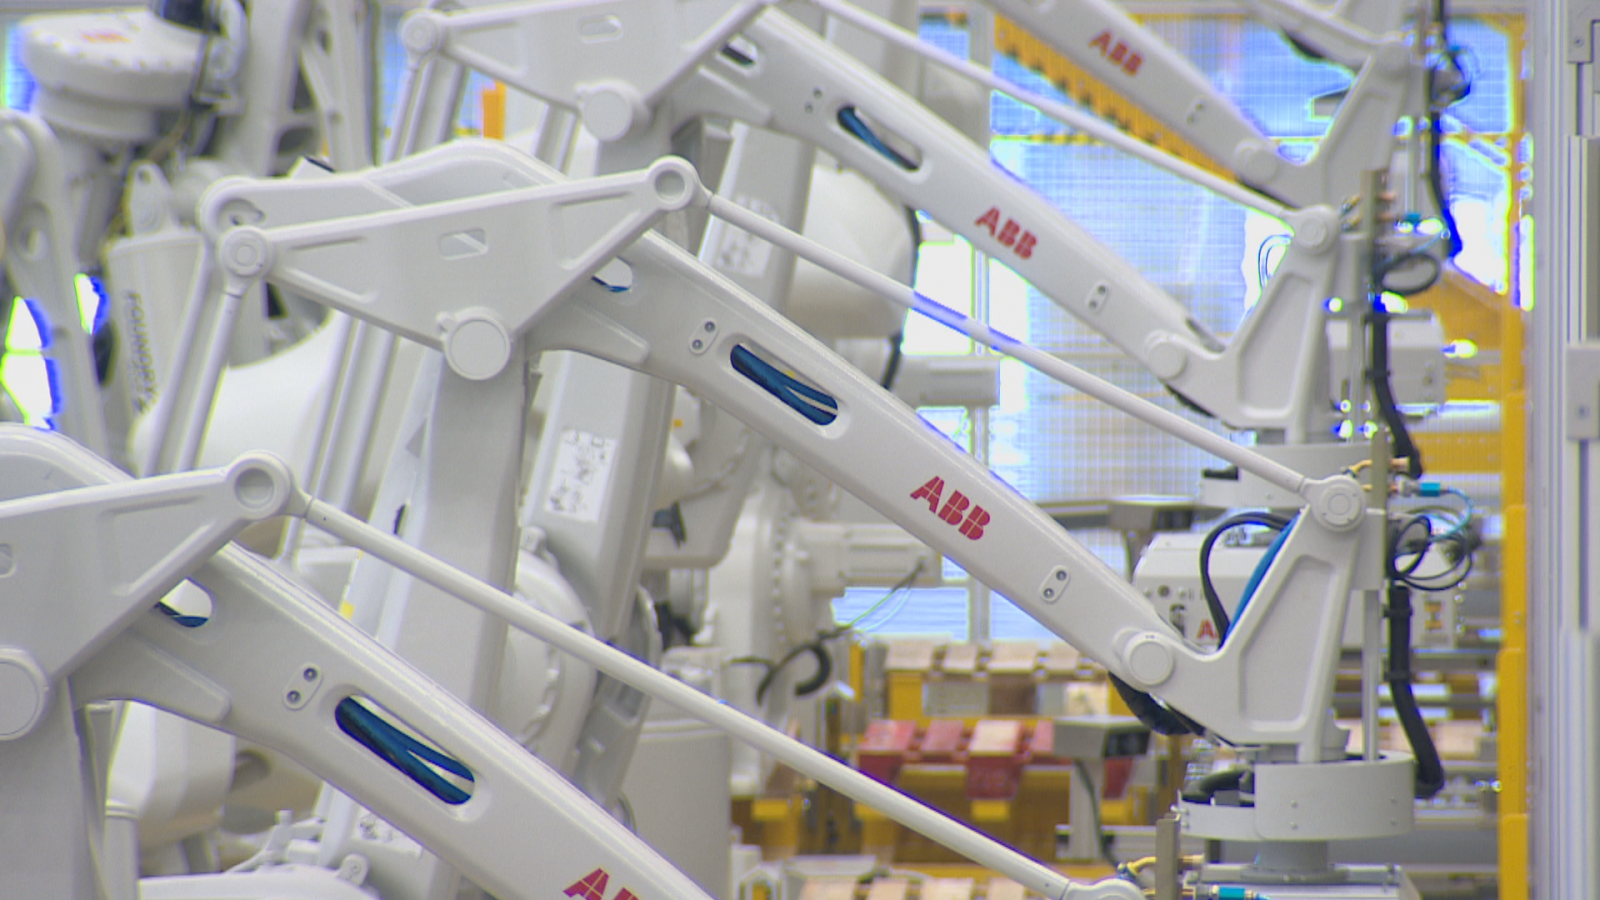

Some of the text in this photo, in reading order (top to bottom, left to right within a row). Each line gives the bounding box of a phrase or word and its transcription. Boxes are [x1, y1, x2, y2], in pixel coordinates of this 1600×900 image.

[1087, 30, 1145, 77] ABB
[974, 205, 1038, 260] ABB
[126, 291, 160, 397] FOUNDRY
[909, 475, 991, 541] ABB
